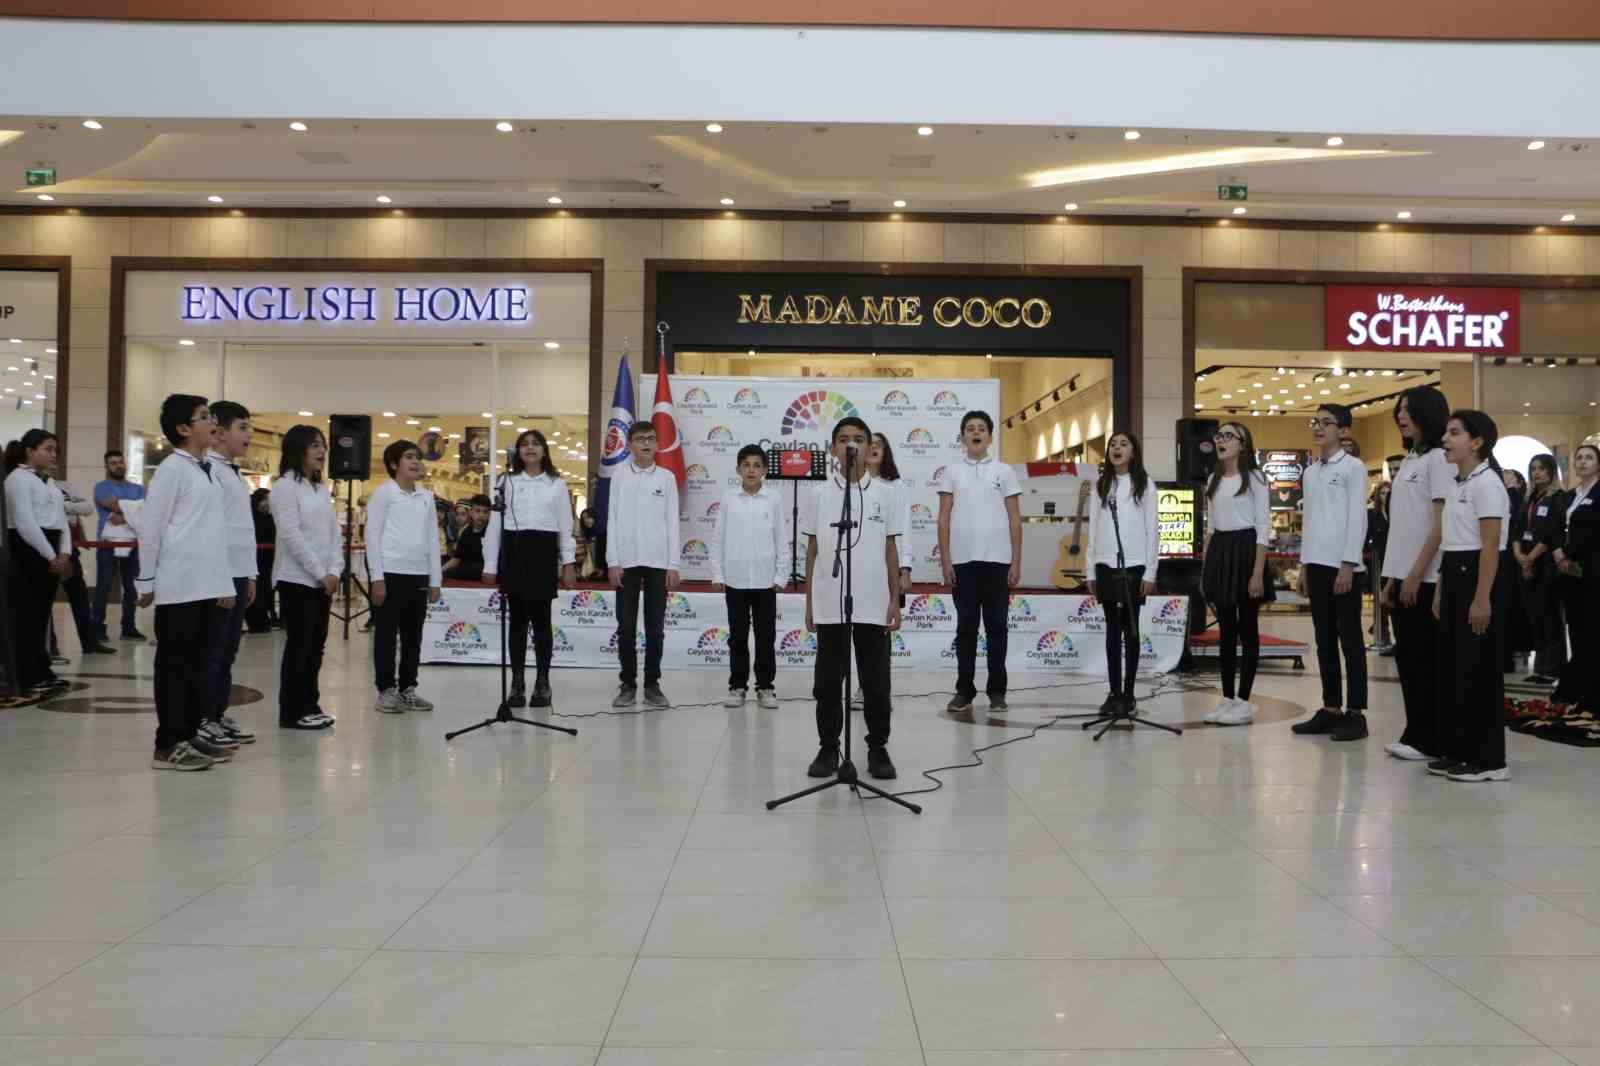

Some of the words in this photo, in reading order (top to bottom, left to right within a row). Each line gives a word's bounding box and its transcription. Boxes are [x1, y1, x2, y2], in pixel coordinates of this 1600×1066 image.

[181, 287, 376, 321] ENGLISH
[394, 288, 529, 321] HOME
[737, 294, 923, 325] MADAME
[933, 297, 1051, 328] COCO
[1347, 312, 1504, 347] SCHAFER
[479, 606, 502, 614] Ceyla
[561, 609, 586, 617] Ceylan
[588, 609, 613, 617] Karavil
[1068, 616, 1092, 624] Ceylan
[434, 641, 460, 649] Ceylan
[462, 641, 487, 649] Karavil
[715, 648, 729, 656] Kara
[1026, 651, 1052, 659] Ceylan
[1054, 651, 1078, 659] Karavil
